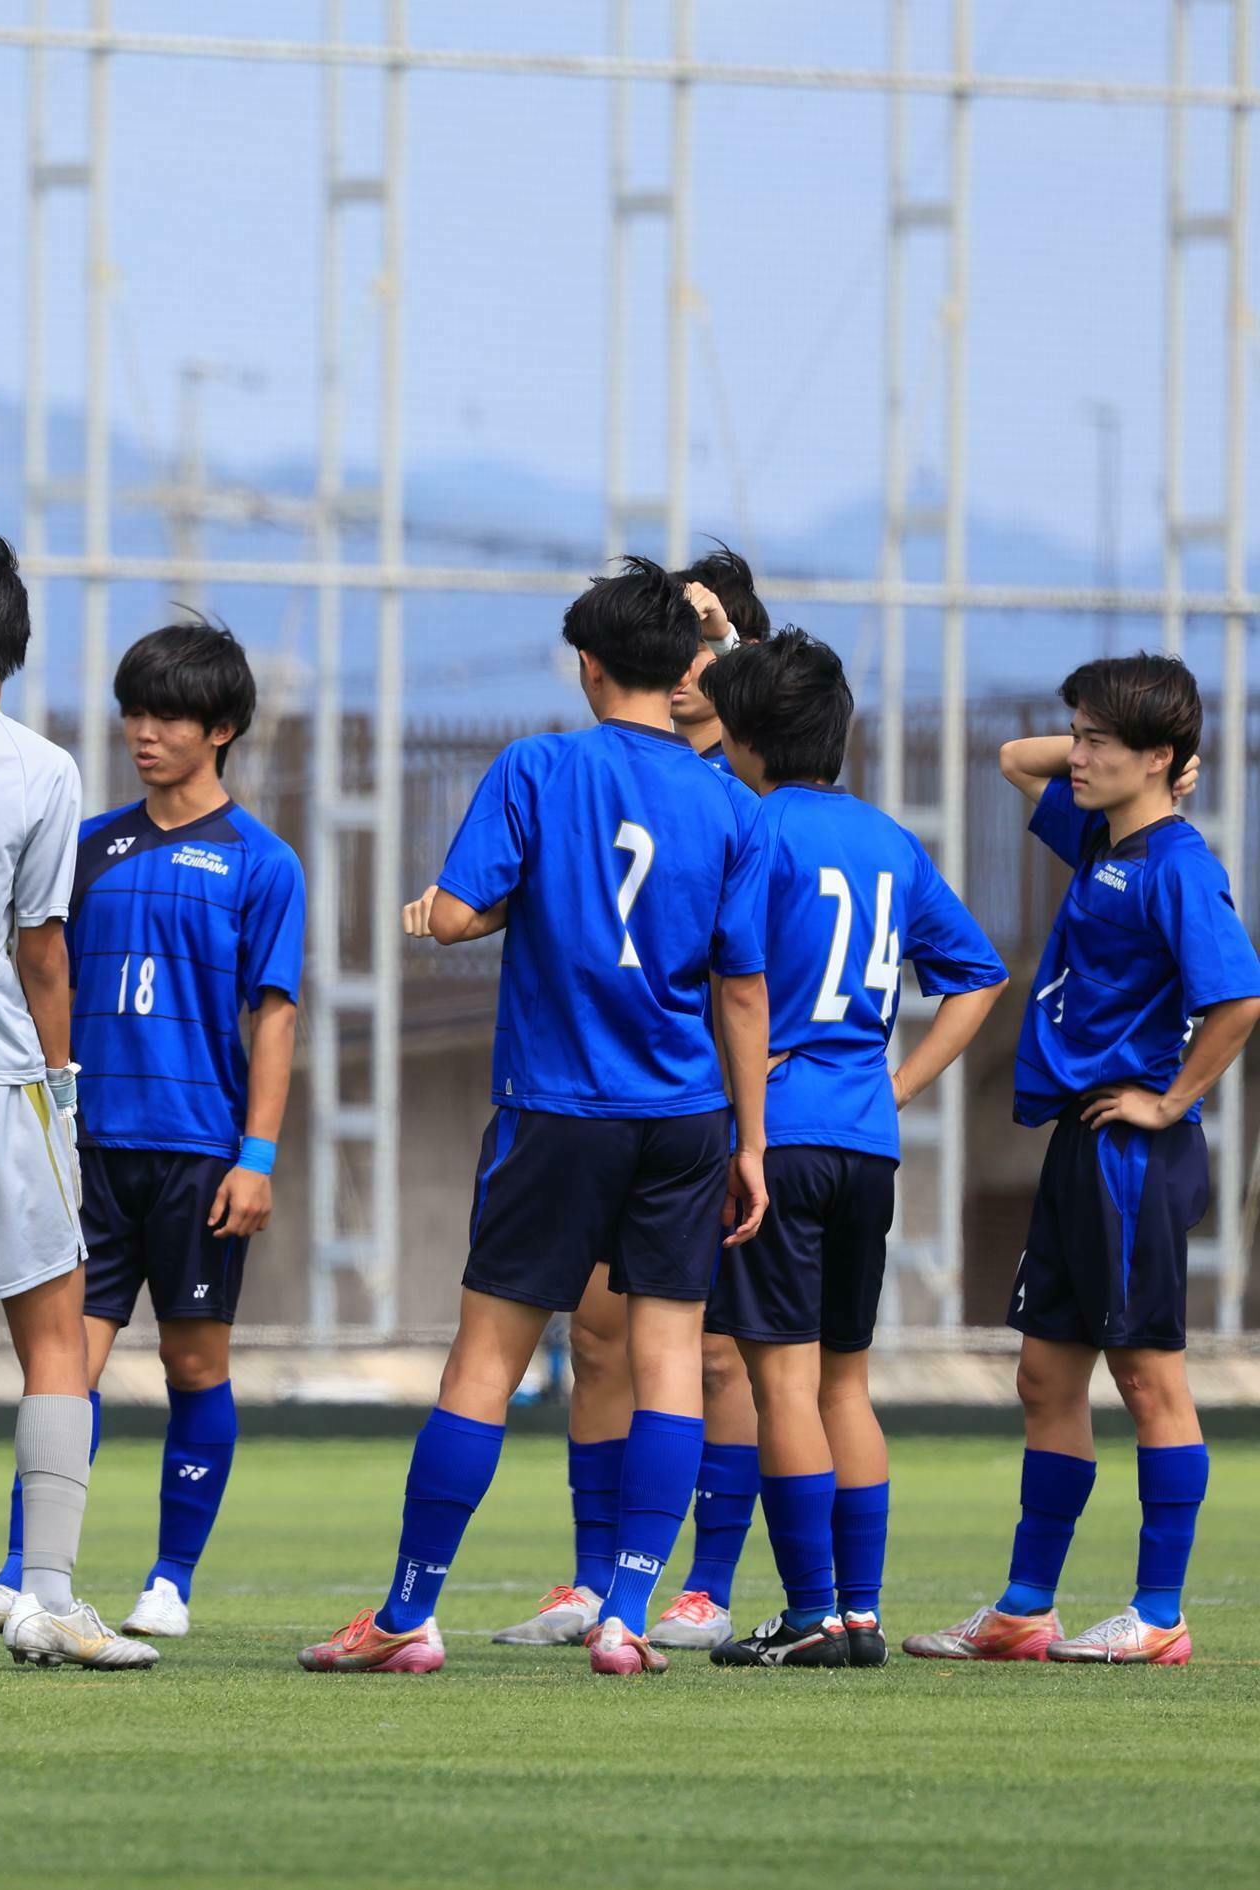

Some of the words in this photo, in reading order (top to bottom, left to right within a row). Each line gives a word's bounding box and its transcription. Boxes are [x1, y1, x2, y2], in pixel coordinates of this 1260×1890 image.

[171, 852, 229, 875] TACHIBANA
[810, 866, 900, 1027] 24
[118, 954, 156, 1016] 18
[401, 1560, 419, 1602] LSOCKS
